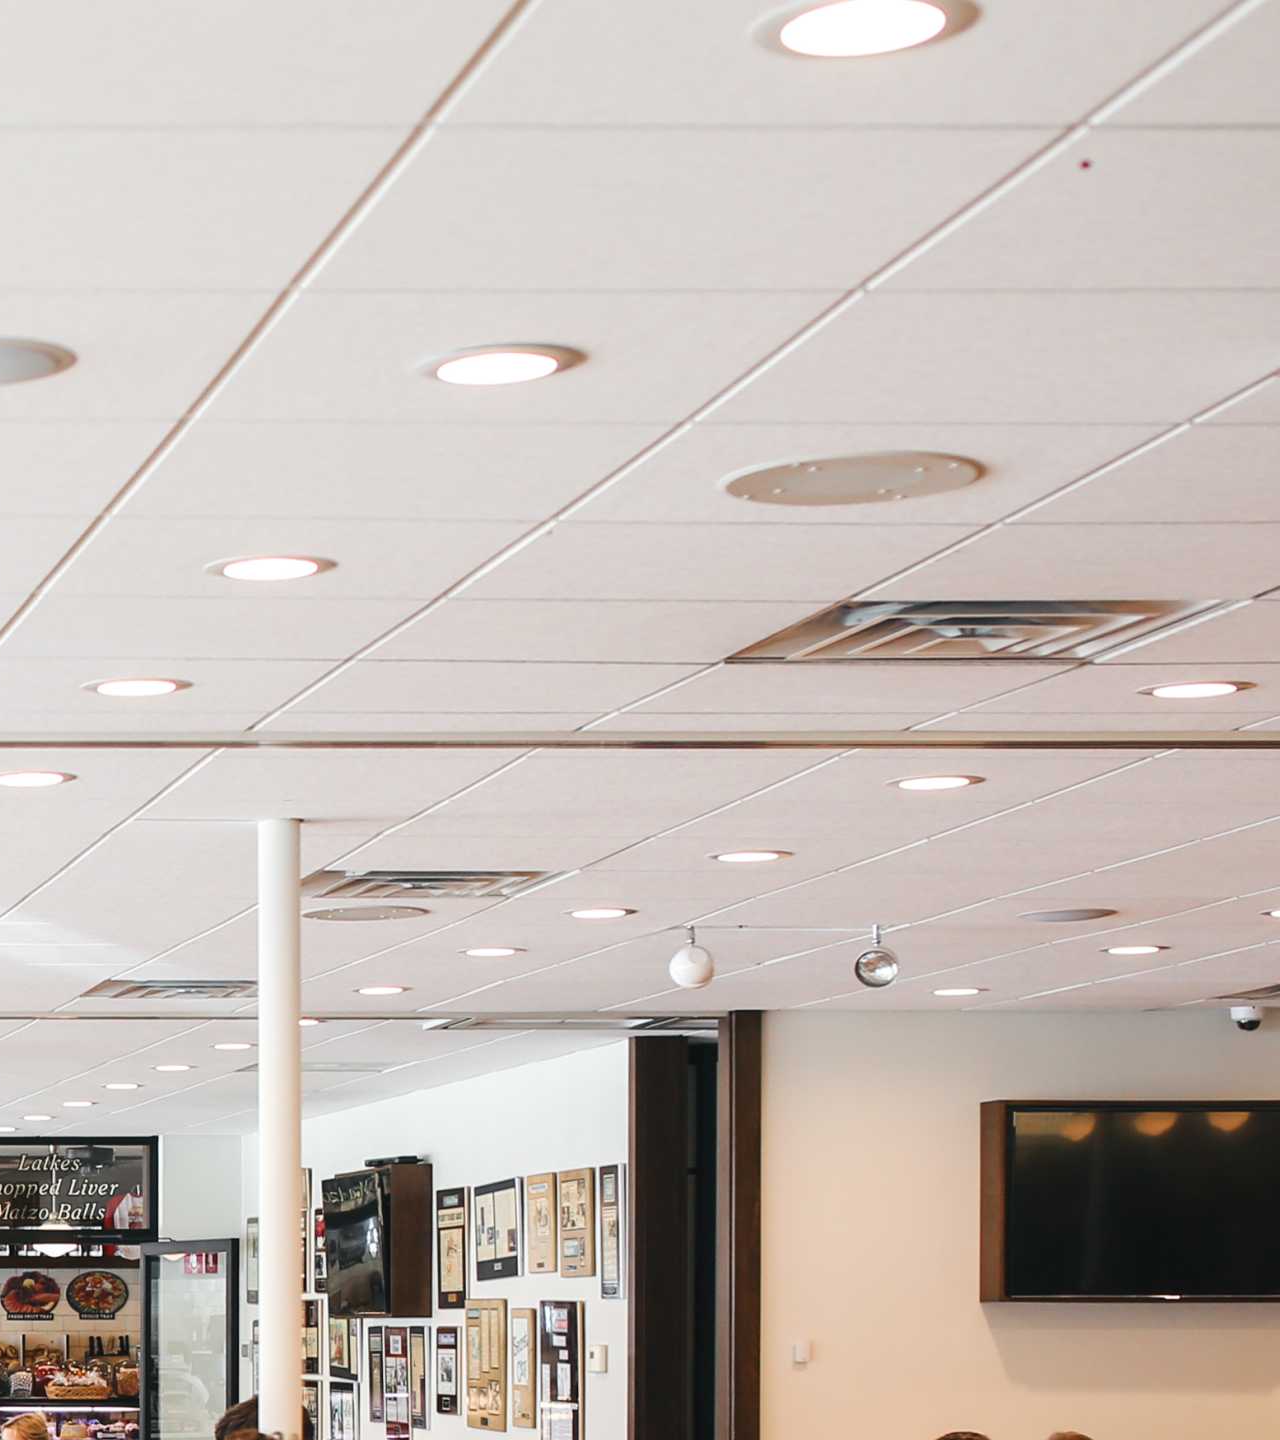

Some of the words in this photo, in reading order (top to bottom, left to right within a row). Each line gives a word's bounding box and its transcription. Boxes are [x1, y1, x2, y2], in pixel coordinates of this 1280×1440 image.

[18, 1154, 81, 1171] Latkes
[68, 1179, 119, 1196] Liver
[57, 1203, 106, 1221] Balls
